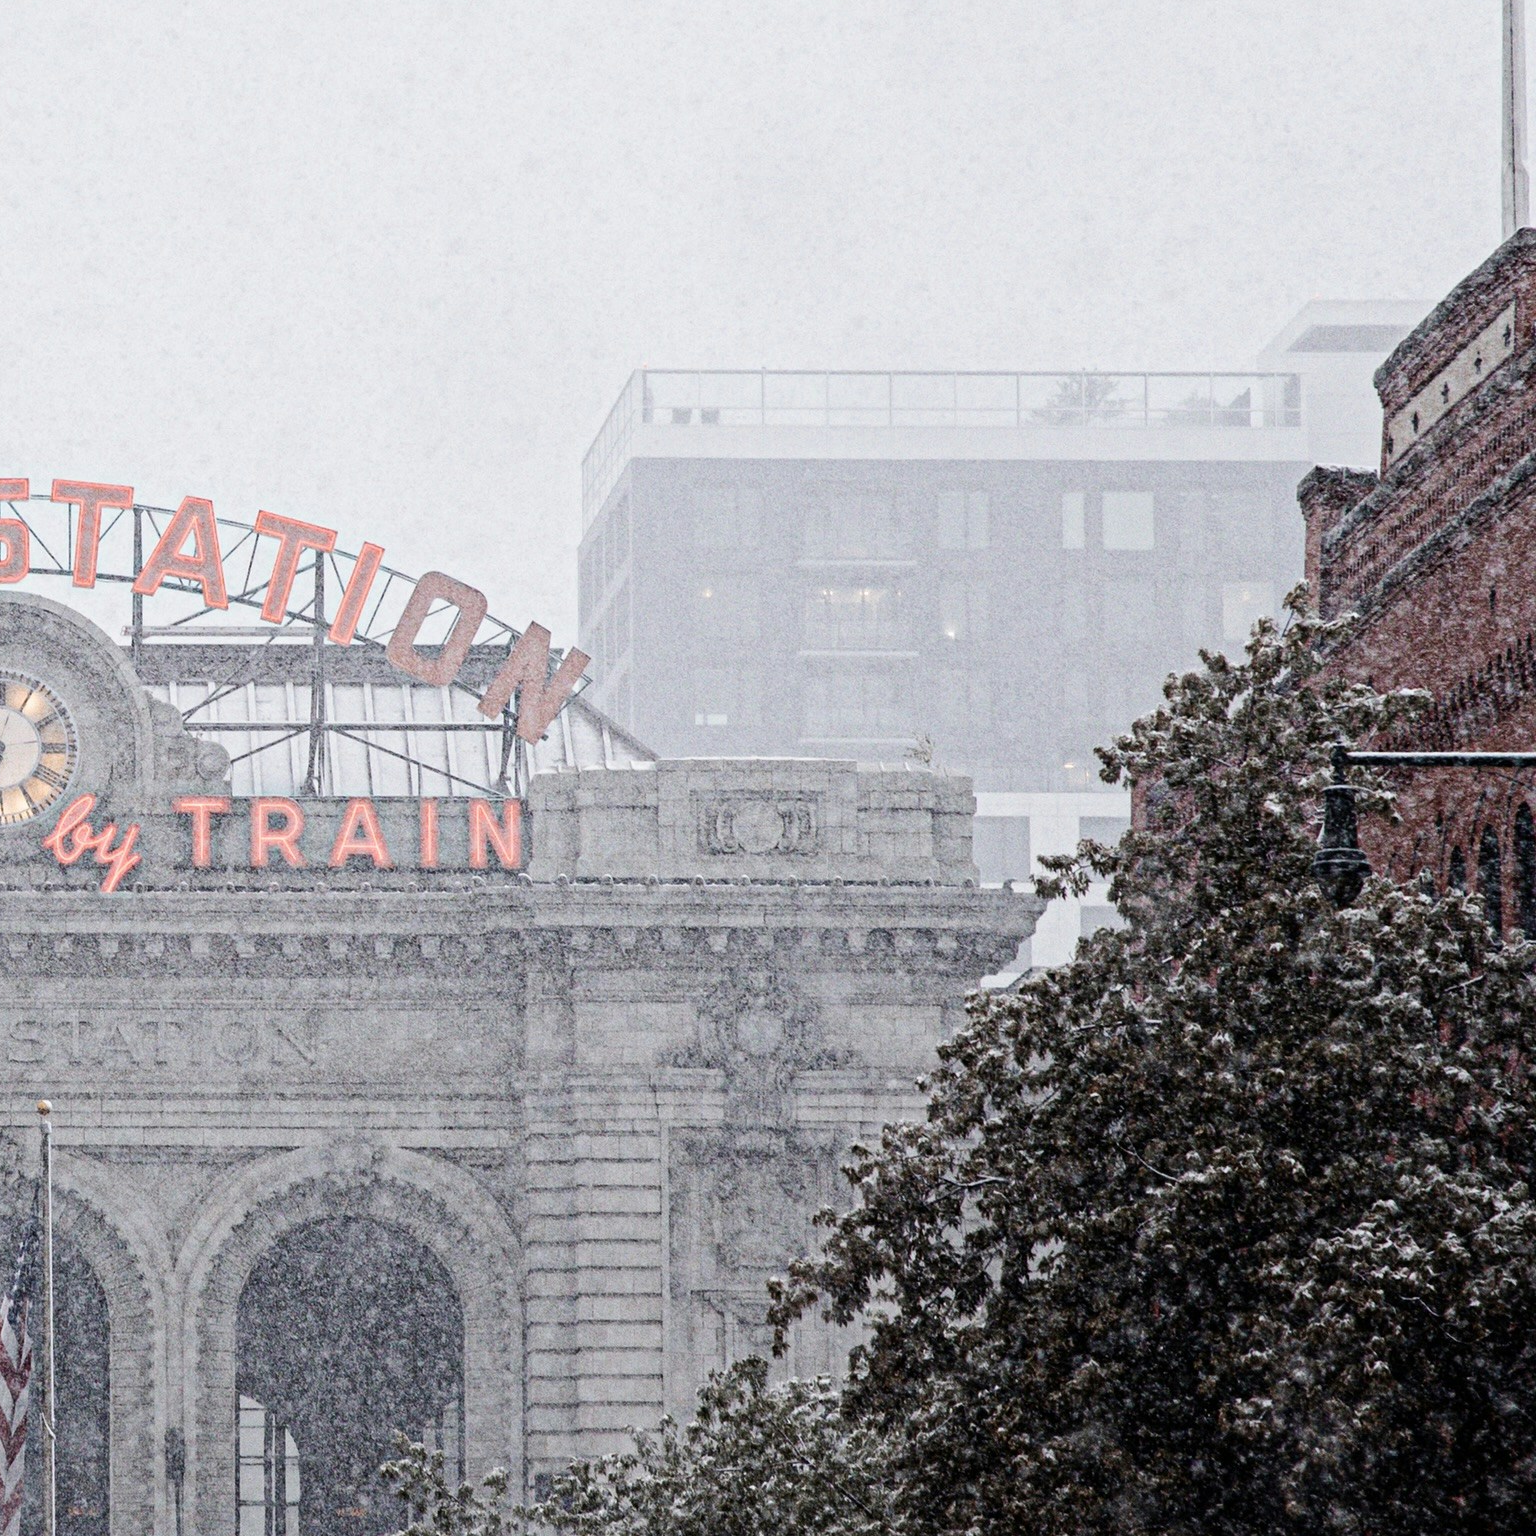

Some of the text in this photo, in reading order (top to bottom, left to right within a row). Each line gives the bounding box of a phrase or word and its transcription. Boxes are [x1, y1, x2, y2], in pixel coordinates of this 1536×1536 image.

[41, 792, 141, 894] by
[174, 796, 523, 871] TRAIN
[7, 1018, 319, 1066] STATION
